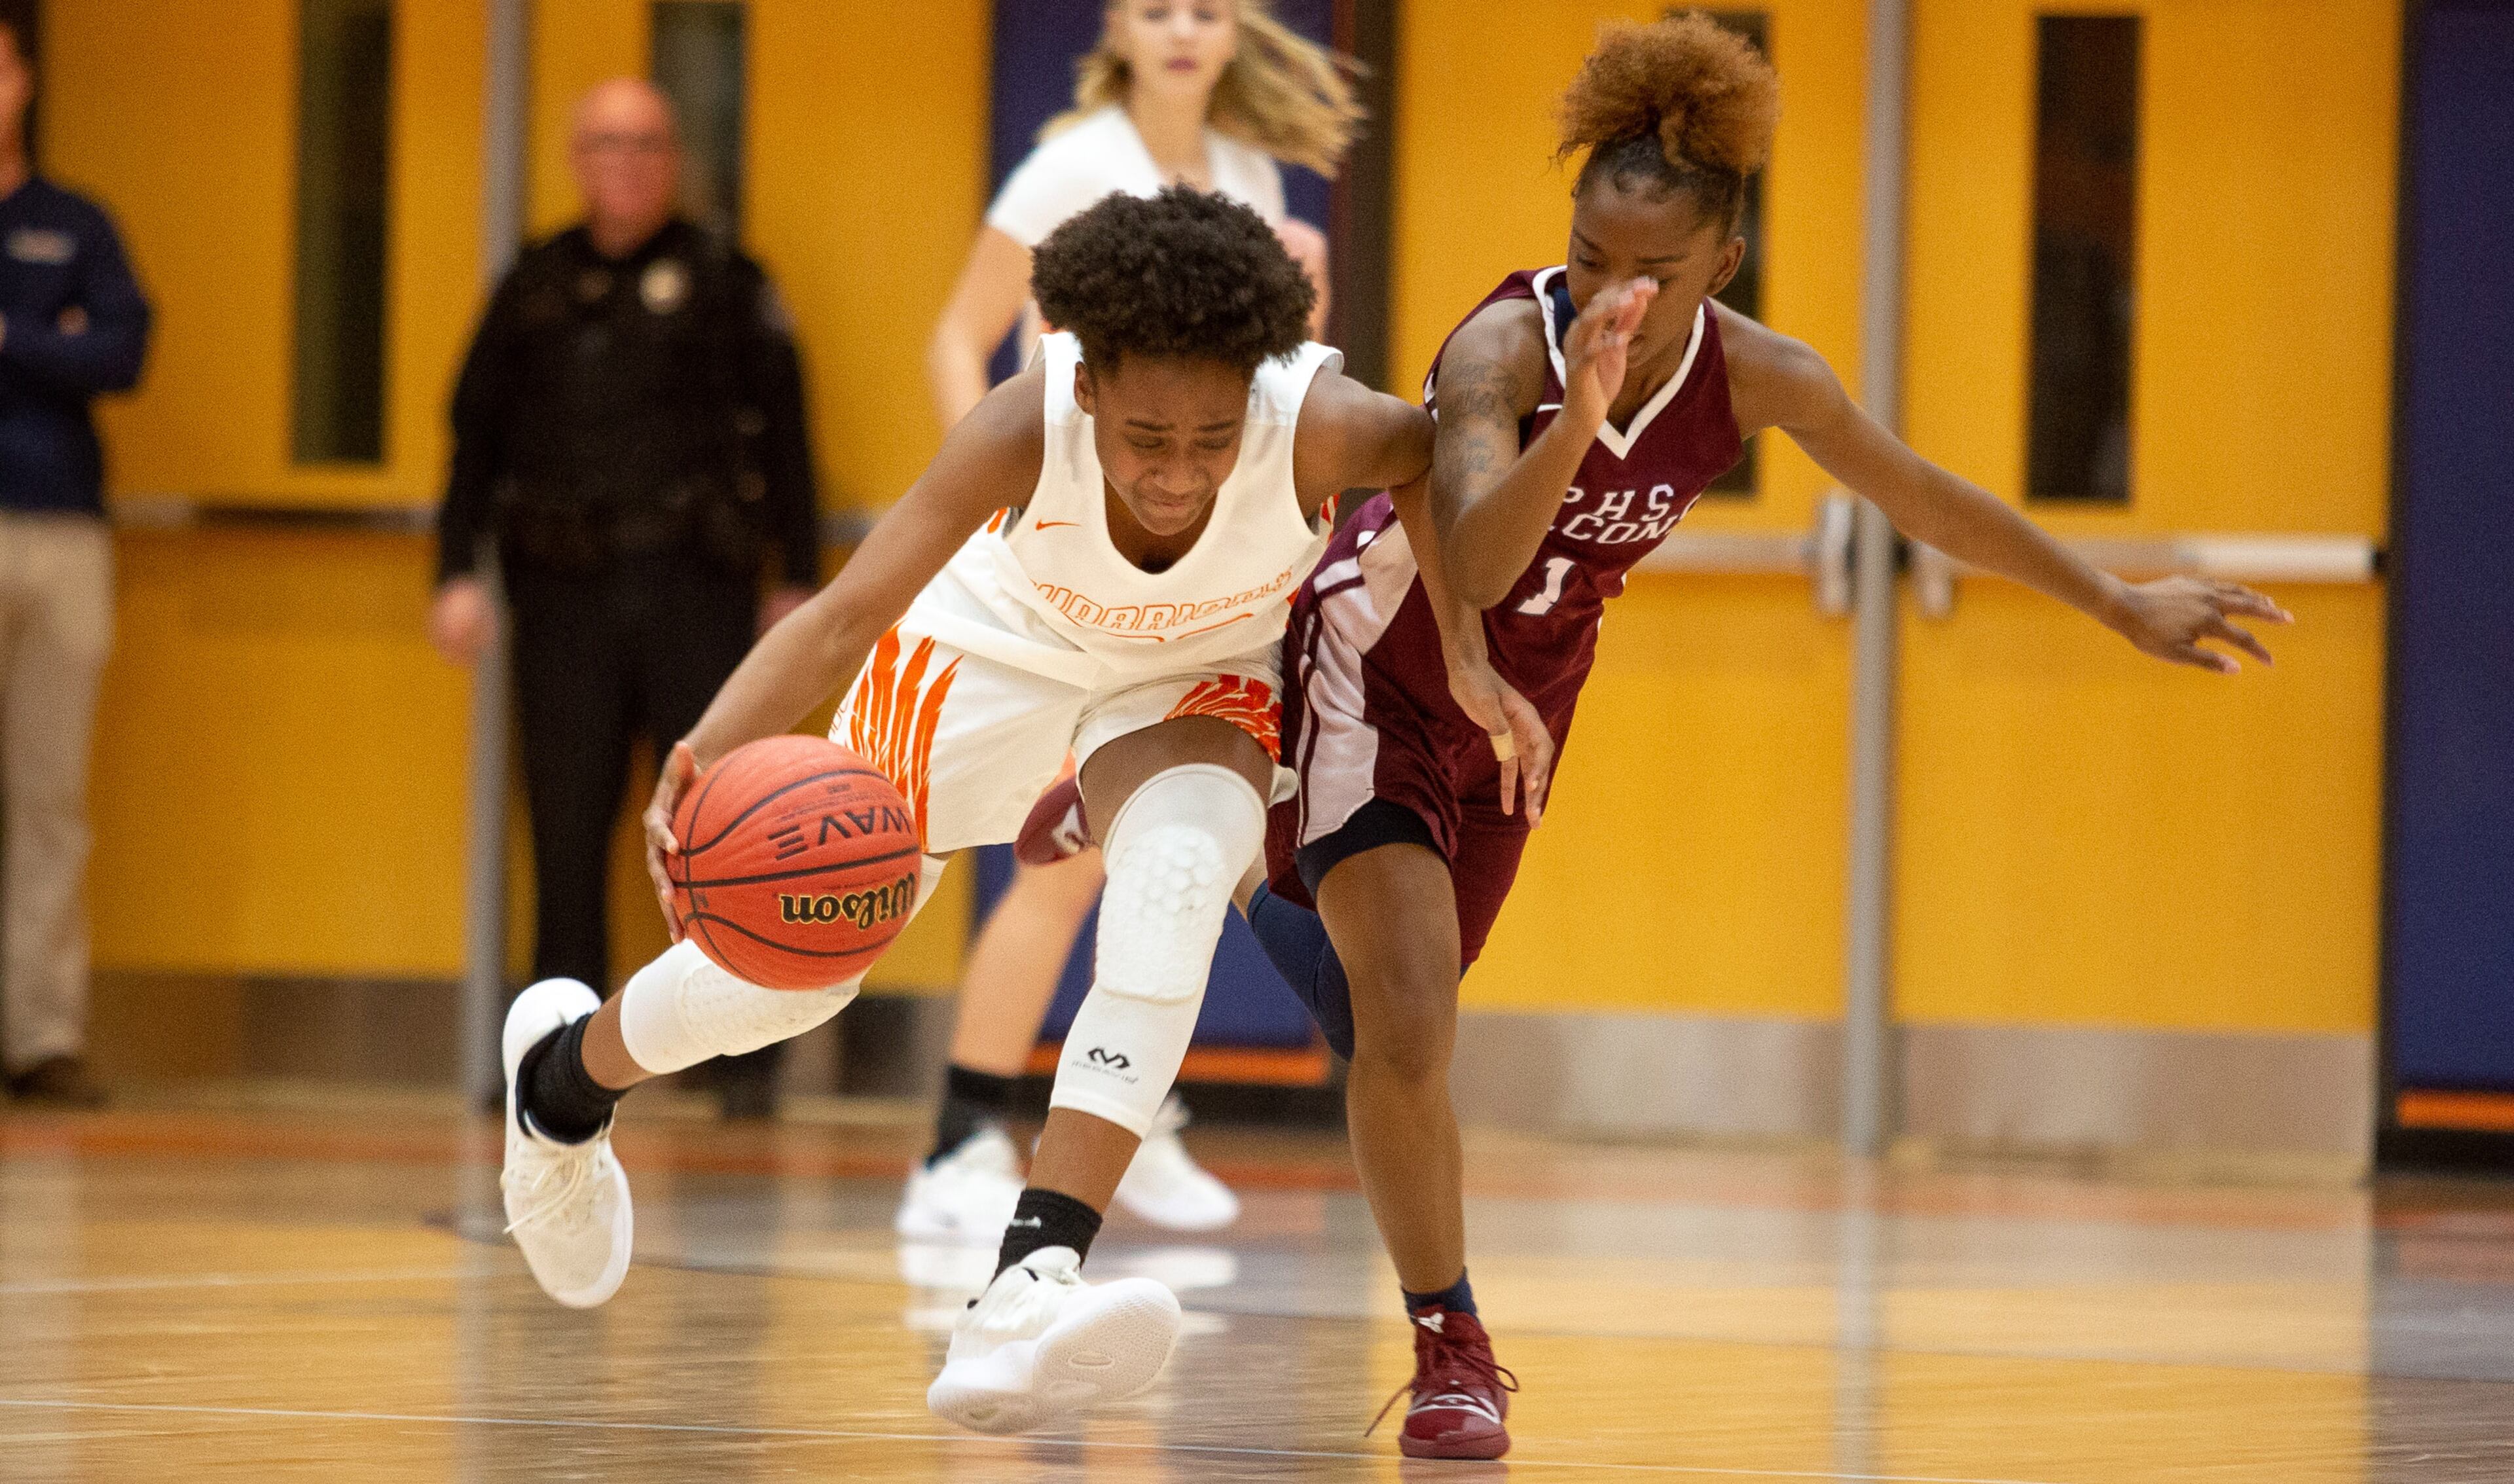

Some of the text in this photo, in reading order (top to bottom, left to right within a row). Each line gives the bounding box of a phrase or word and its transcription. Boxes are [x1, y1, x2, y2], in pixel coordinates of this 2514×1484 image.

[1548, 513, 1679, 543] CON
[1518, 556, 1575, 615] 1
[767, 806, 912, 861] WAVE
[779, 871, 916, 932] Wilson
